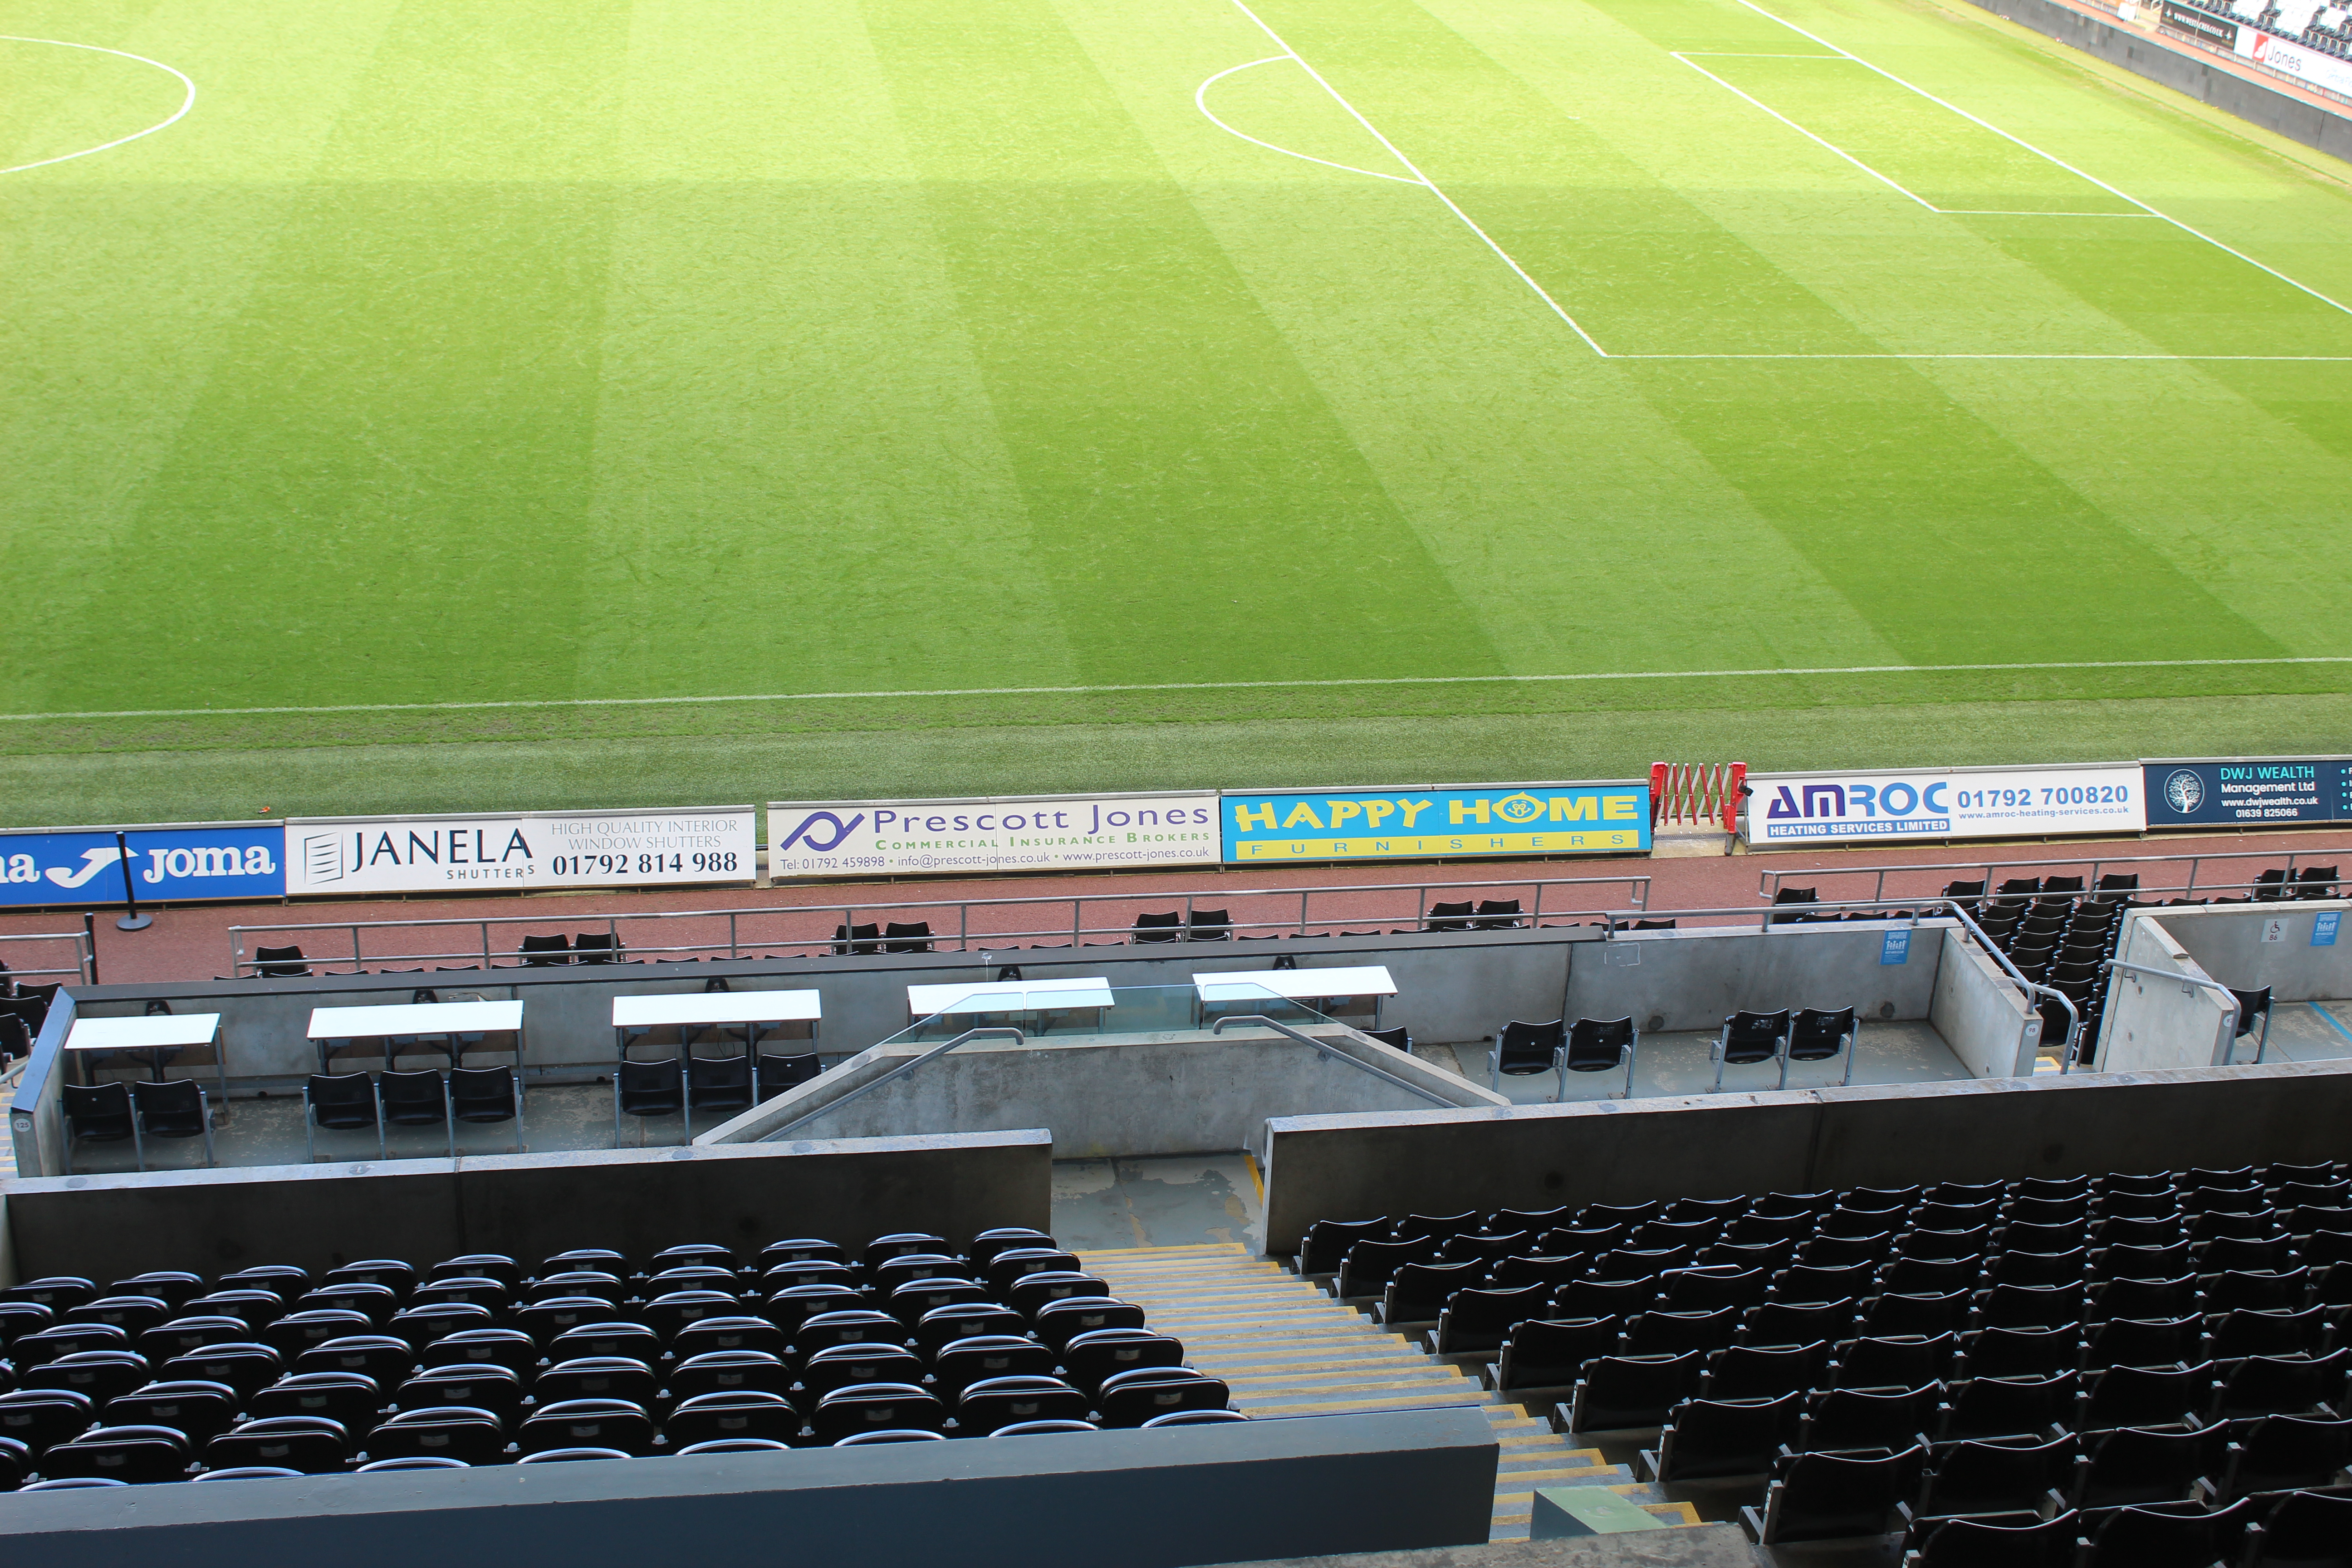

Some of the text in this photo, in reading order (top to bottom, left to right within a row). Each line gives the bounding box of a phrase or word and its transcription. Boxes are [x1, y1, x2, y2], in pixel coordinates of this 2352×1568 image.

[2268, 46, 2302, 71] Jones
[2220, 765, 2314, 780] DWJ WEALTH
[1957, 785, 2128, 808] 01792 700820
[2221, 781, 2315, 795] Management Ltd
[2221, 796, 2318, 808] www.dwjwealth.co.uk
[874, 804, 1209, 834] Prescott Jones
[1235, 791, 1638, 832] HAPPY HOME
[1958, 806, 2129, 819] www.amroc-heating-services.co.uk
[2235, 808, 2298, 818] 01639 825066
[552, 819, 738, 836] HIGH QUALITY INTERIOR
[1770, 820, 1947, 836] HEATING SERVICES LIMITED
[351, 828, 533, 873] JANELA
[568, 835, 721, 850] WINDOW SHUTTERS
[1251, 834, 1625, 855] FURNISHERS
[553, 852, 738, 876] 01792 814 988
[780, 846, 1210, 870] Tel: 01792 459898 info@prescott-jones.co.uk www.prescott-jones.co.uk
[446, 864, 535, 880] SHUTTERS
